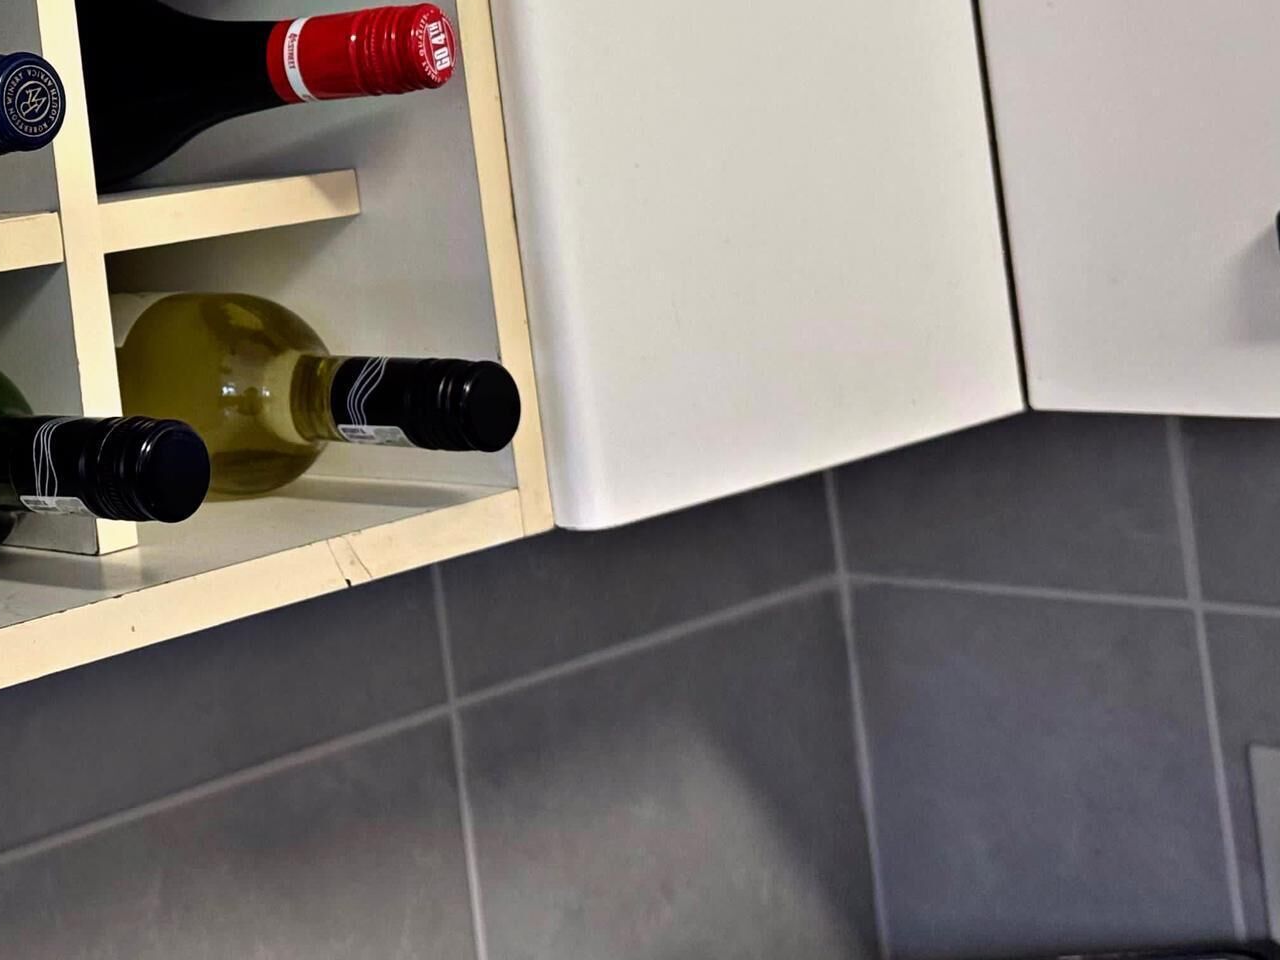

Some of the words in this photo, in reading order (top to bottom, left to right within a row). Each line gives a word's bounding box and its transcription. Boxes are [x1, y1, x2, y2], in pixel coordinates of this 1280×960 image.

[433, 46, 451, 72] GO
[6, 71, 24, 105] WINERY
[26, 68, 54, 87] AFRICA
[48, 88, 59, 121] SOUTH
[7, 107, 49, 134] ROBERTSON
